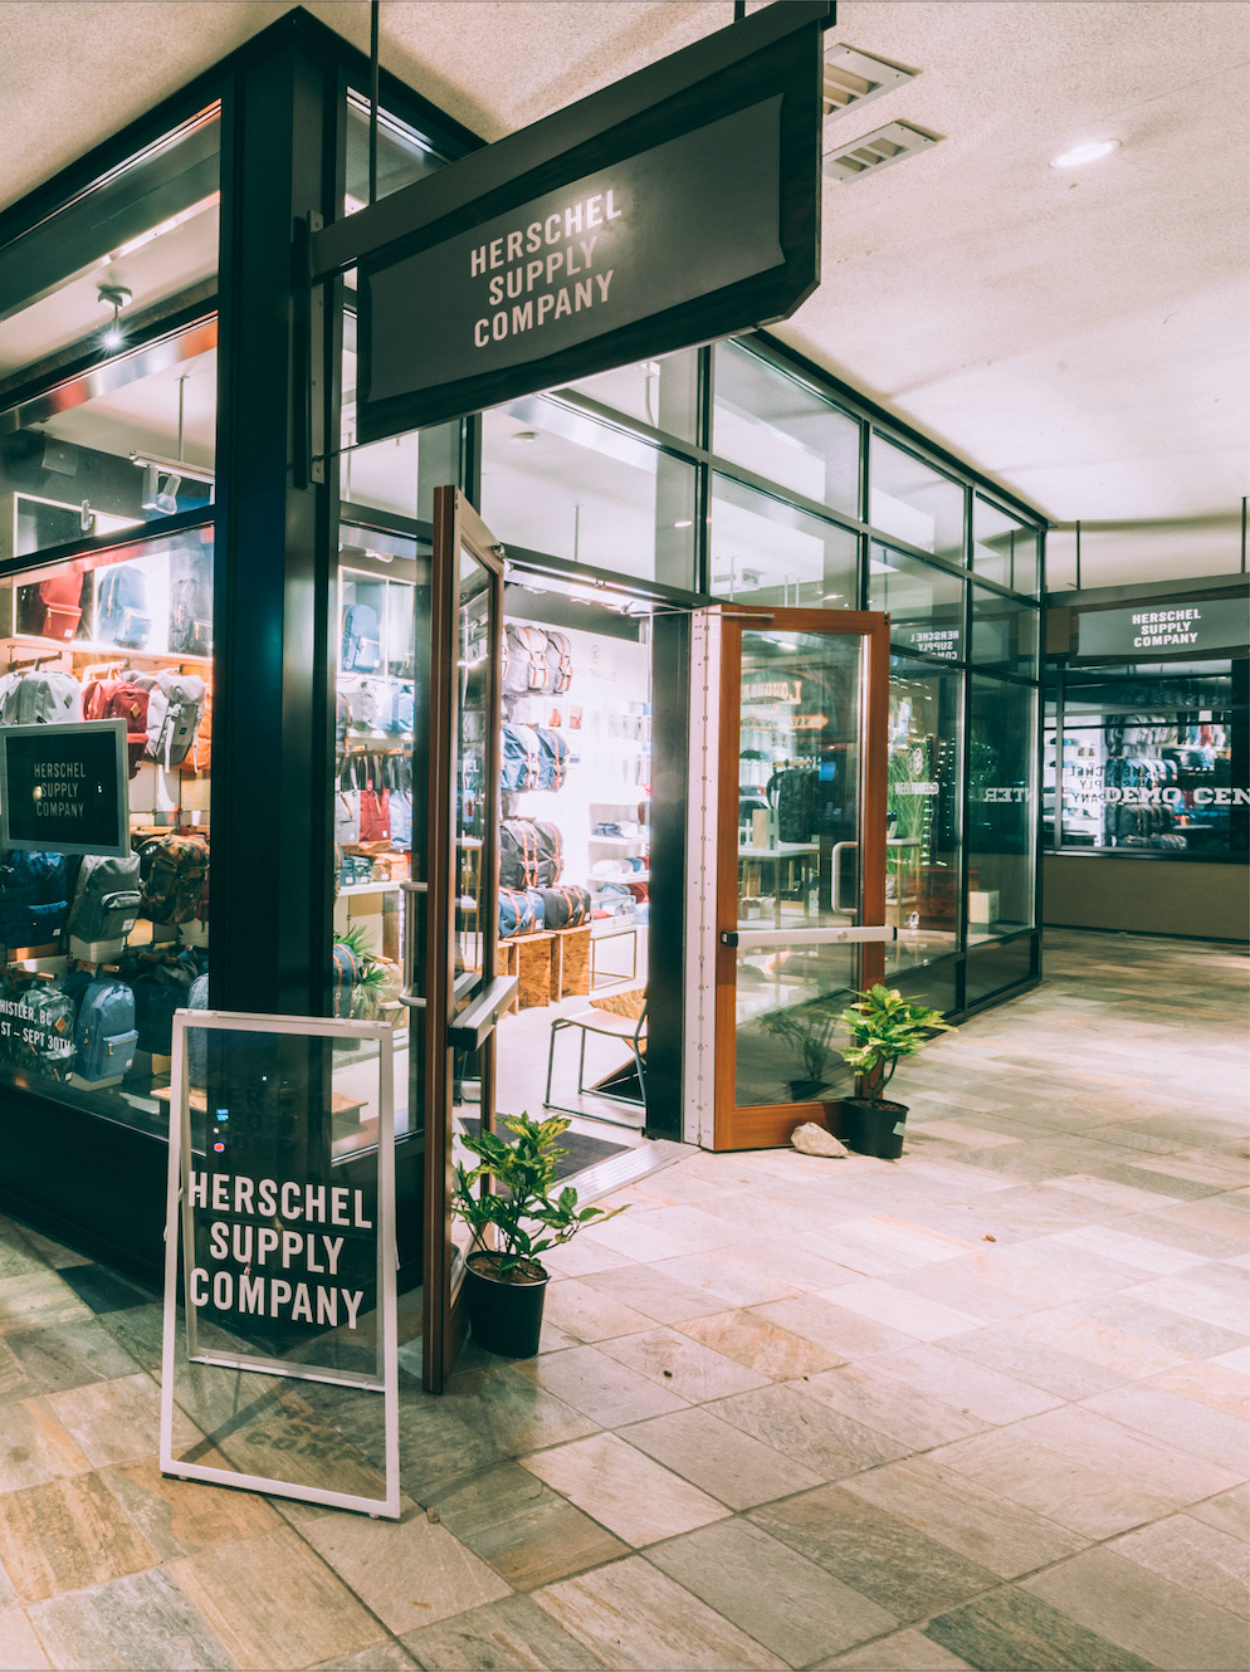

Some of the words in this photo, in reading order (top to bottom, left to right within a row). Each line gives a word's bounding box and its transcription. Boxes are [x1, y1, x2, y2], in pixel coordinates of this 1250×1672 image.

[470, 189, 622, 278] HERSCHEL
[488, 236, 597, 306] SUPPLY
[474, 269, 615, 348] COMPANY
[1132, 608, 1202, 625] HERSCHEL
[1141, 621, 1191, 635] SUPPLY
[1133, 632, 1198, 647] COMPANY
[34, 762, 86, 778] HERSCHEL
[41, 782, 79, 798] SUPPLY
[1104, 786, 1182, 803] DEMO
[36, 802, 84, 817] COMPANY
[39, 1009, 53, 1027] BC
[22, 1027, 45, 1047] SEPT
[47, 1035, 71, 1053] 30TH
[188, 1171, 372, 1229] HERSCHEL
[209, 1222, 344, 1275] SUPPLY
[189, 1268, 364, 1330] COMPANY
